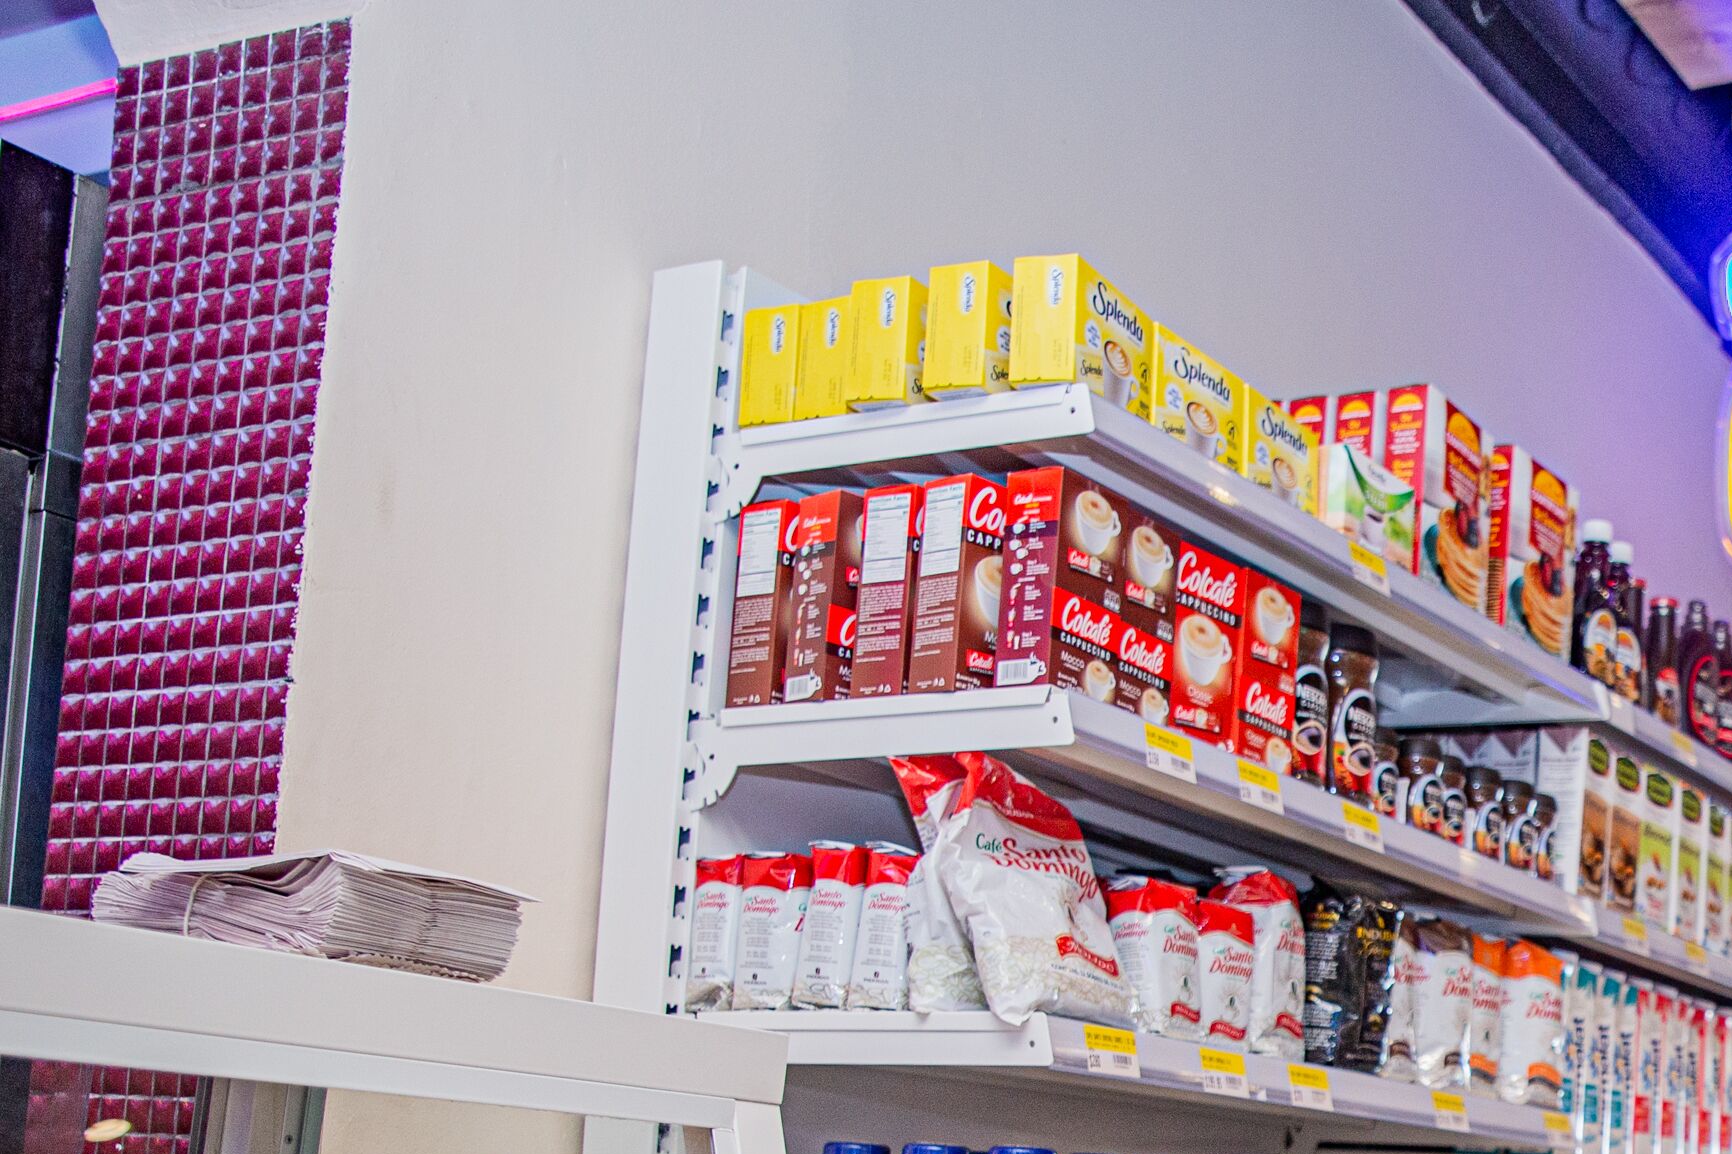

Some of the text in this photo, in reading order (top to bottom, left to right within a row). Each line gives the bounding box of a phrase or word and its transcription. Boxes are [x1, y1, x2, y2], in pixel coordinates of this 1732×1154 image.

[1093, 281, 1143, 342] Splenda
[1174, 346, 1231, 401] Splenda
[1261, 406, 1308, 456] Splenda
[1177, 551, 1237, 607] Colcafé
[1061, 597, 1113, 646] Colcafé
[1060, 632, 1111, 662] CAPPUCCINO
[1120, 627, 1166, 674] Colcafé
[1119, 662, 1165, 689] CAPPUCCINO
[1246, 682, 1288, 725] Colcafé
[976, 833, 1086, 864] Café Santo
